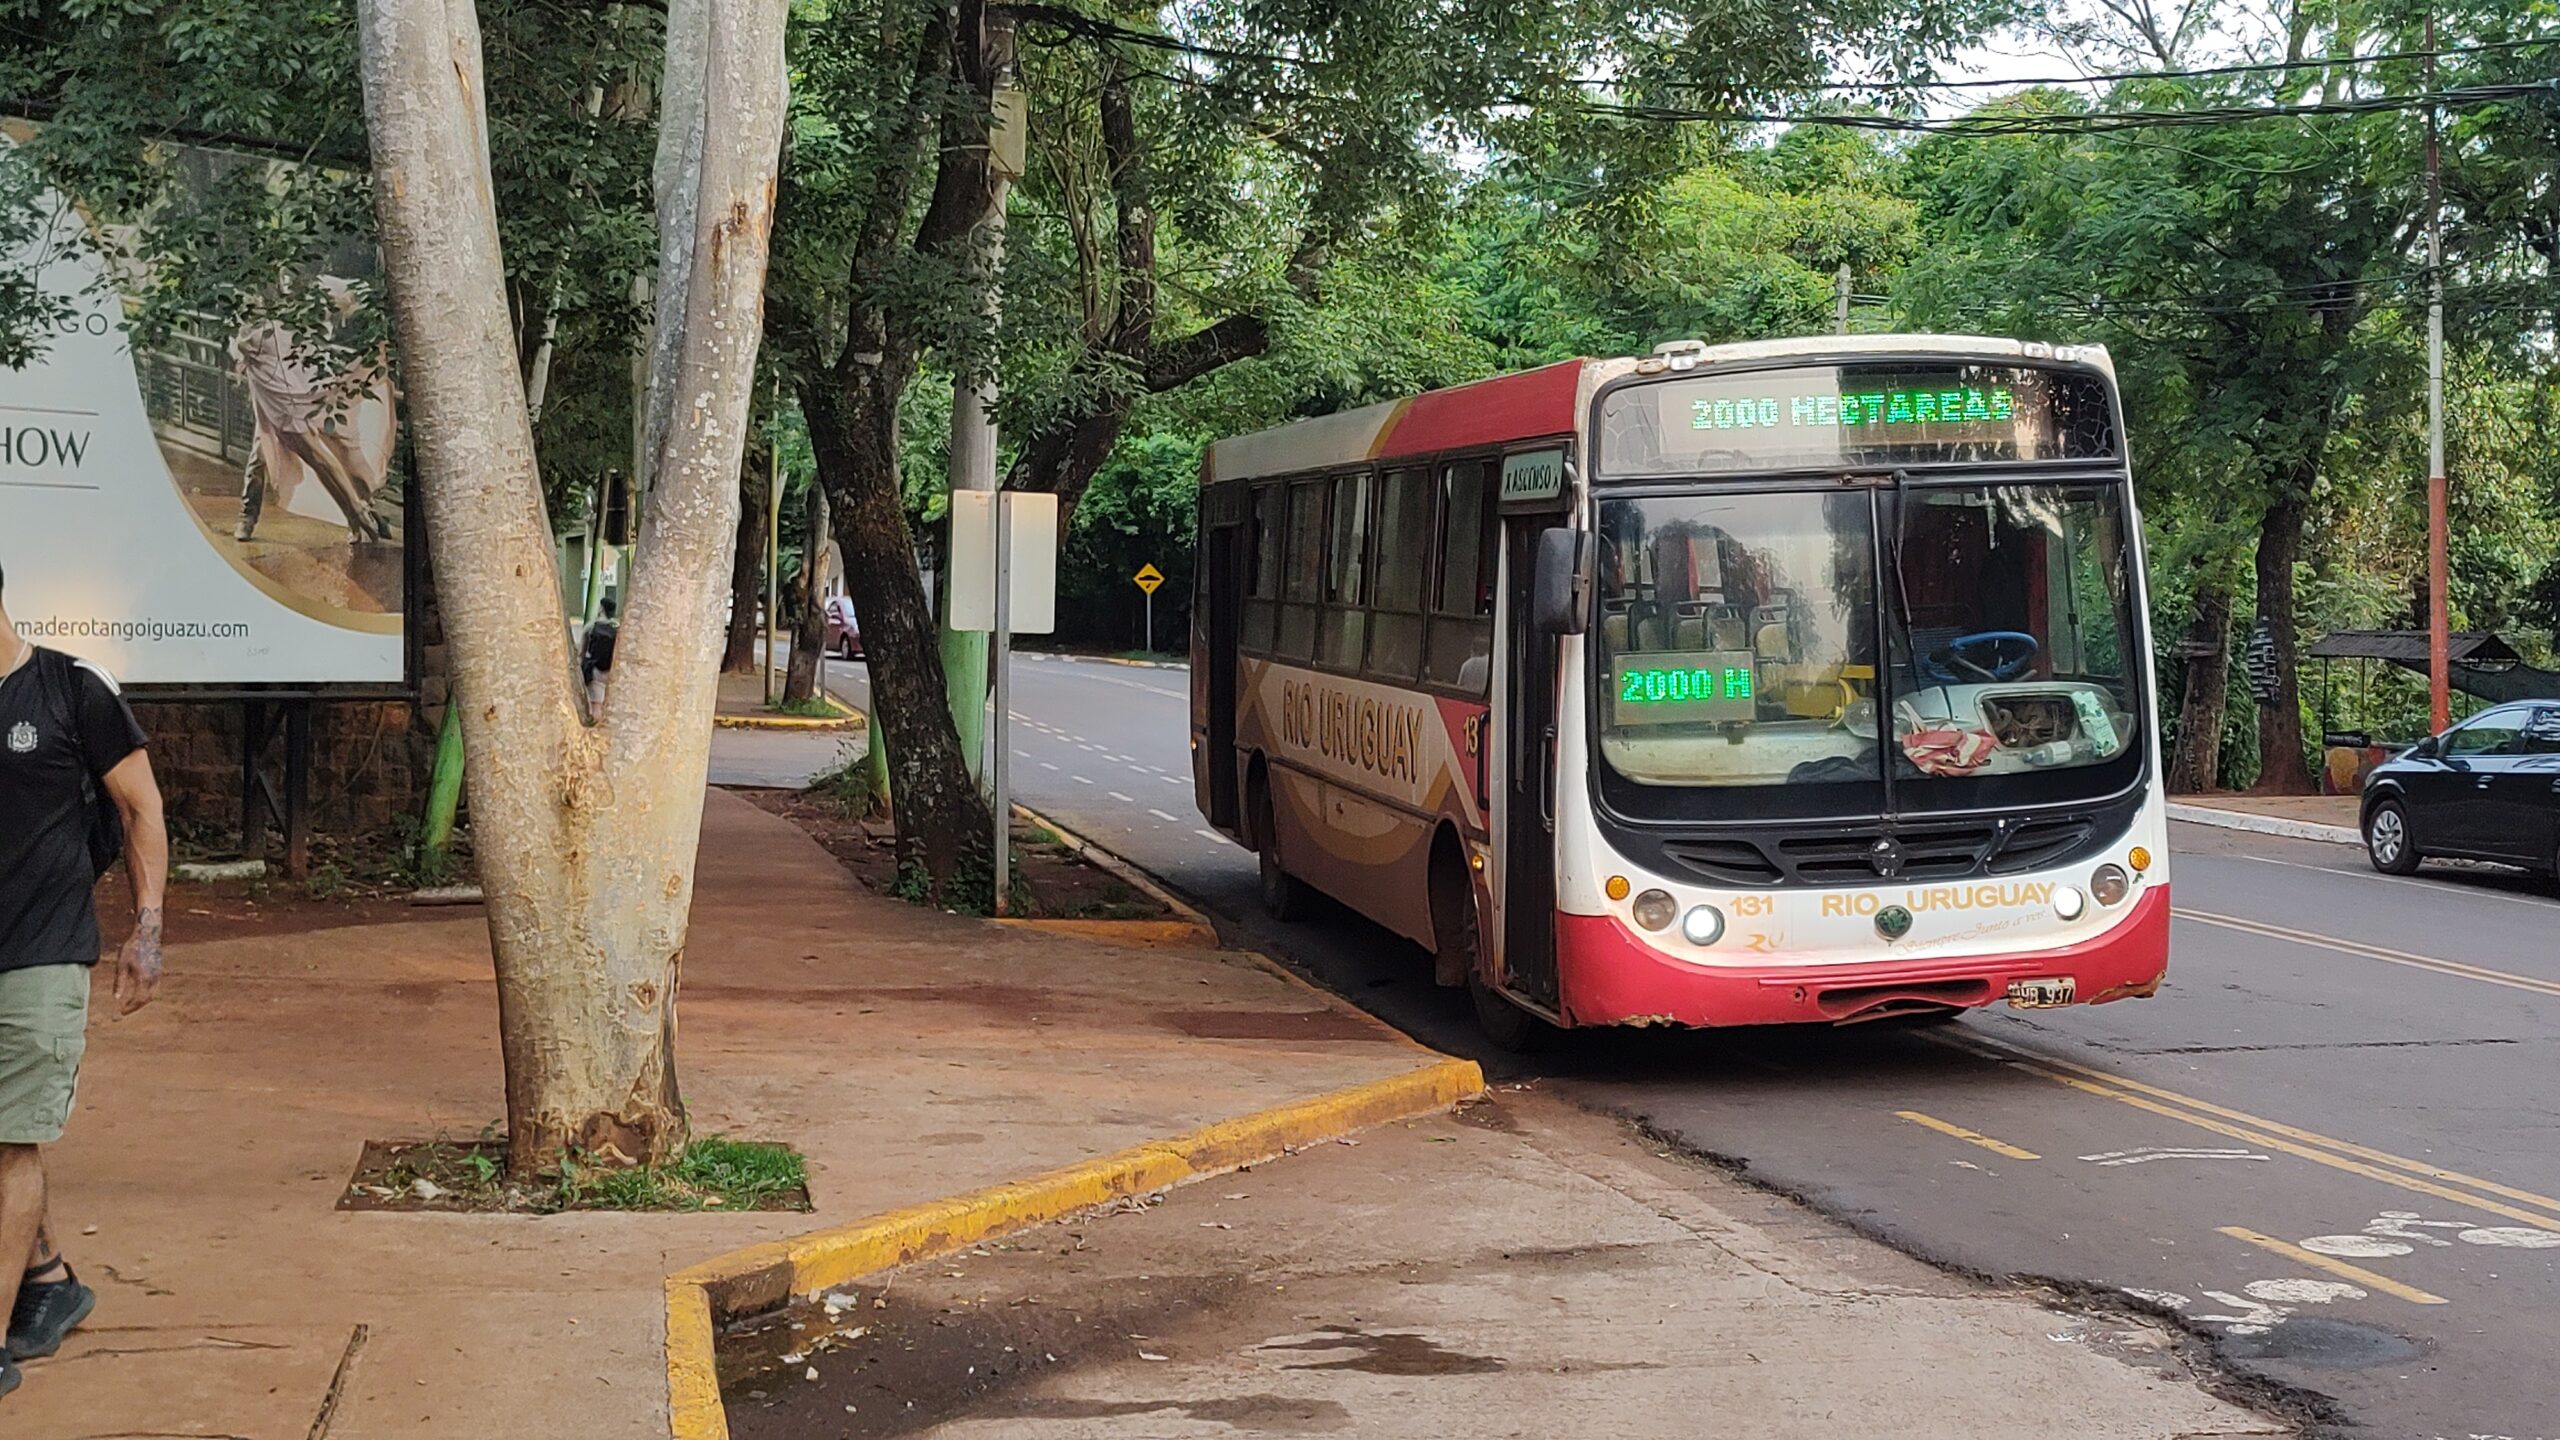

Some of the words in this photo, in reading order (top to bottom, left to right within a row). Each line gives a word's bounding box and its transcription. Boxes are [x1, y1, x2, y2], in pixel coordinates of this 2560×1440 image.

[1690, 396, 1779, 430] 2000
[1790, 390, 2014, 426] HECTAREAS
[14, 615, 249, 641] maderotangoiguazu.com
[1621, 668, 1713, 701] 2000
[1724, 667, 1751, 698] H
[1283, 679, 1313, 748] RIO
[1319, 688, 1424, 784] URUGUAY
[1729, 894, 1774, 917] 131
[1821, 892, 1881, 917] RIO
[1906, 882, 2056, 913] URUGUAY
[2046, 986, 2073, 1004] 937
